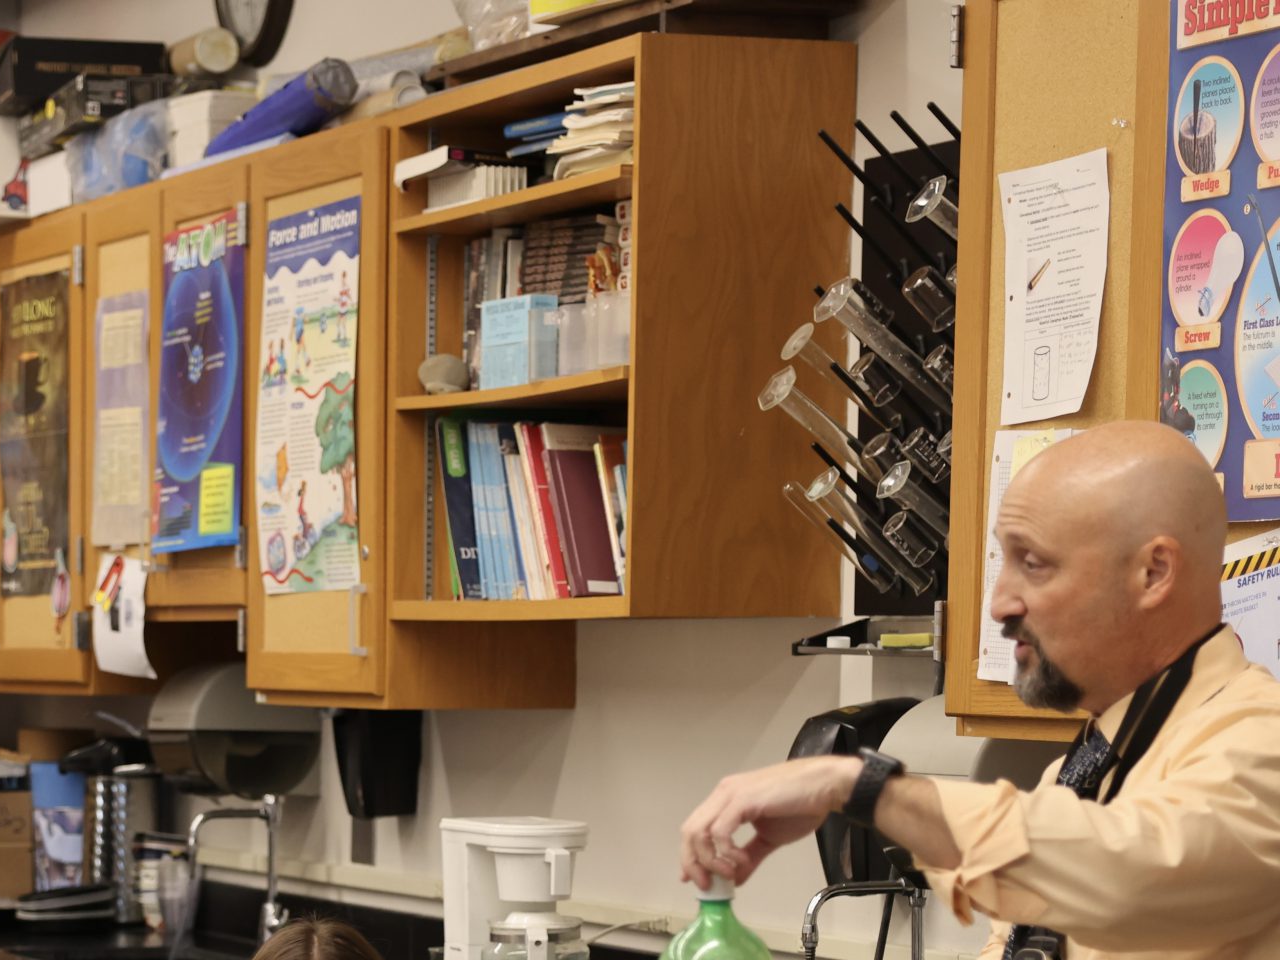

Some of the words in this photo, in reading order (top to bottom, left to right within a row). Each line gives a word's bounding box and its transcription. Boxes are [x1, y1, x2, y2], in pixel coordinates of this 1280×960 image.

[1192, 178, 1220, 192] Wedge
[269, 228, 298, 248] Force
[299, 217, 319, 241] and
[321, 209, 358, 232] Motion
[173, 219, 226, 272] ATOM
[1184, 330, 1211, 344] Screw
[1237, 571, 1266, 588] SAFETY
